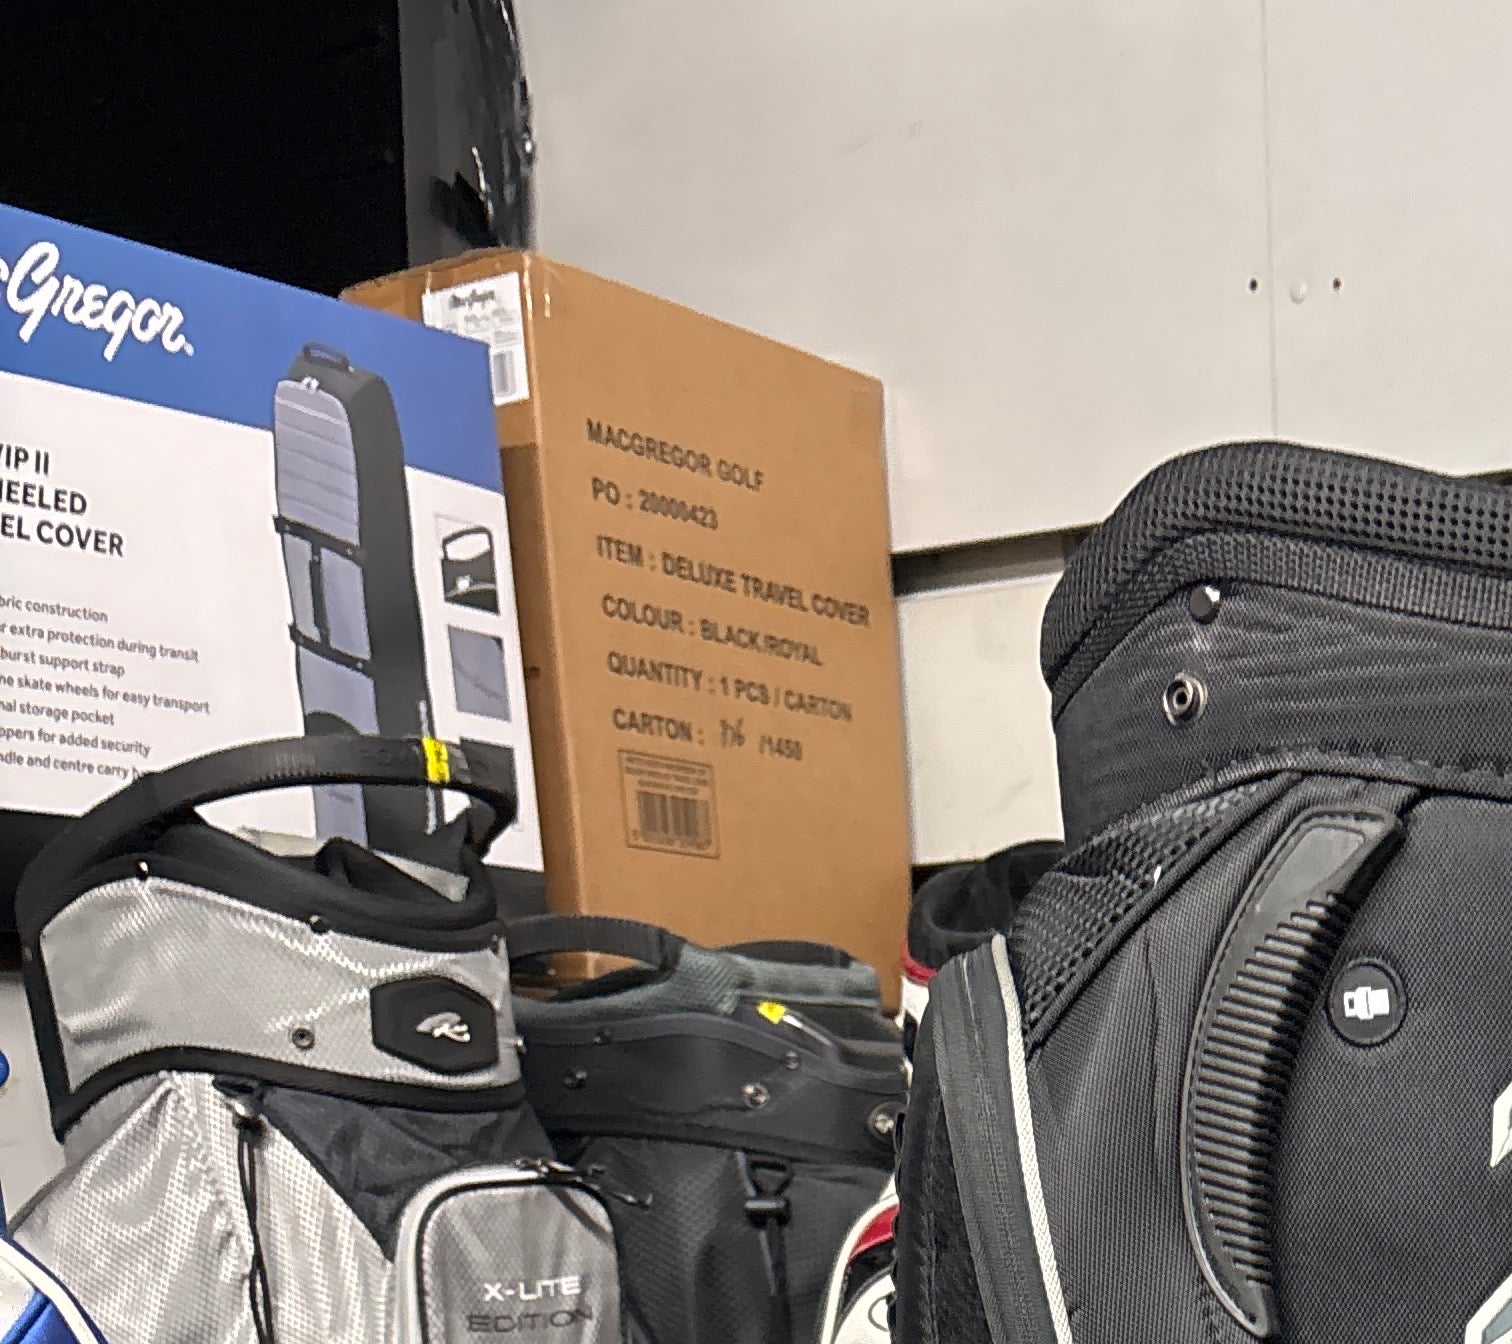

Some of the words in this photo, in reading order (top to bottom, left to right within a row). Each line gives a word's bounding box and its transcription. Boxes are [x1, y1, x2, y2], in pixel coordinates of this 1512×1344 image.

[0, 241, 195, 362] Gregor
[587, 417, 714, 478] MACGREGOR
[717, 458, 764, 491] GOLF
[591, 476, 620, 506] PO
[36, 519, 124, 557] COVER
[596, 535, 643, 567] ITEM
[740, 572, 808, 612] TRAVEL
[811, 594, 870, 627] COVER
[25, 599, 108, 623] construction
[601, 593, 684, 633] COLOUR
[9, 624, 45, 639] extra
[47, 628, 114, 649] protection
[117, 636, 157, 660] during
[159, 643, 199, 664] transit
[39, 651, 88, 671] support
[92, 660, 125, 679] strap
[17, 673, 52, 692] skate
[55, 681, 99, 698] wheels
[102, 685, 120, 700] for
[122, 691, 151, 708] easy
[152, 693, 210, 715] transport
[606, 651, 702, 692] QUANTITY
[783, 690, 853, 723] CARTON
[19, 701, 69, 722] storage
[71, 708, 115, 726] pocket
[612, 707, 692, 743] CARTON
[38, 727, 56, 743] for
[59, 731, 98, 748] added
[101, 737, 151, 758] security
[27, 754, 50, 769] and
[53, 758, 94, 776] centre
[97, 763, 129, 780] carry
[484, 1275, 582, 1302] X-LITE
[466, 1305, 594, 1333] EDITION
